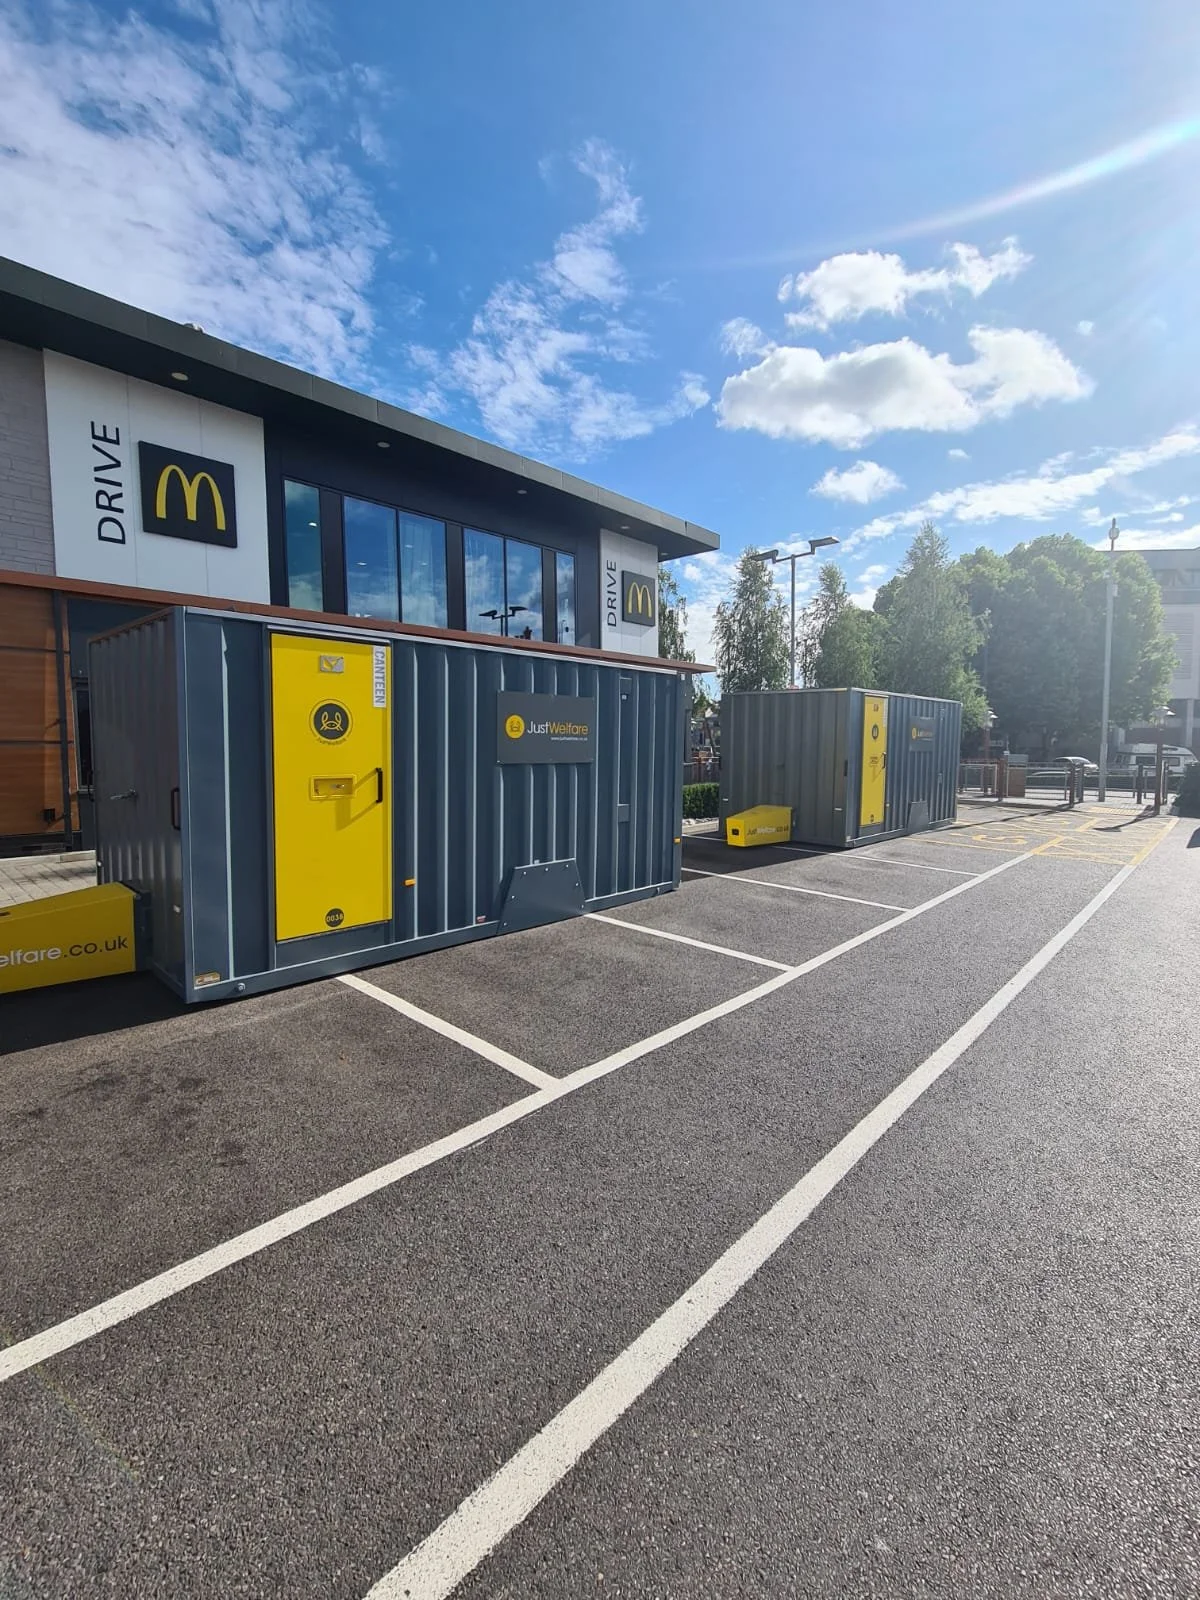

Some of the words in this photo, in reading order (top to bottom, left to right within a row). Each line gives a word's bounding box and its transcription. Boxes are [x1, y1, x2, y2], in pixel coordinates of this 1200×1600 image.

[91, 421, 125, 543] DRIVE
[607, 560, 617, 626] DRIVE
[375, 650, 385, 704] CANTEEN
[527, 720, 589, 735] JustWelfare
